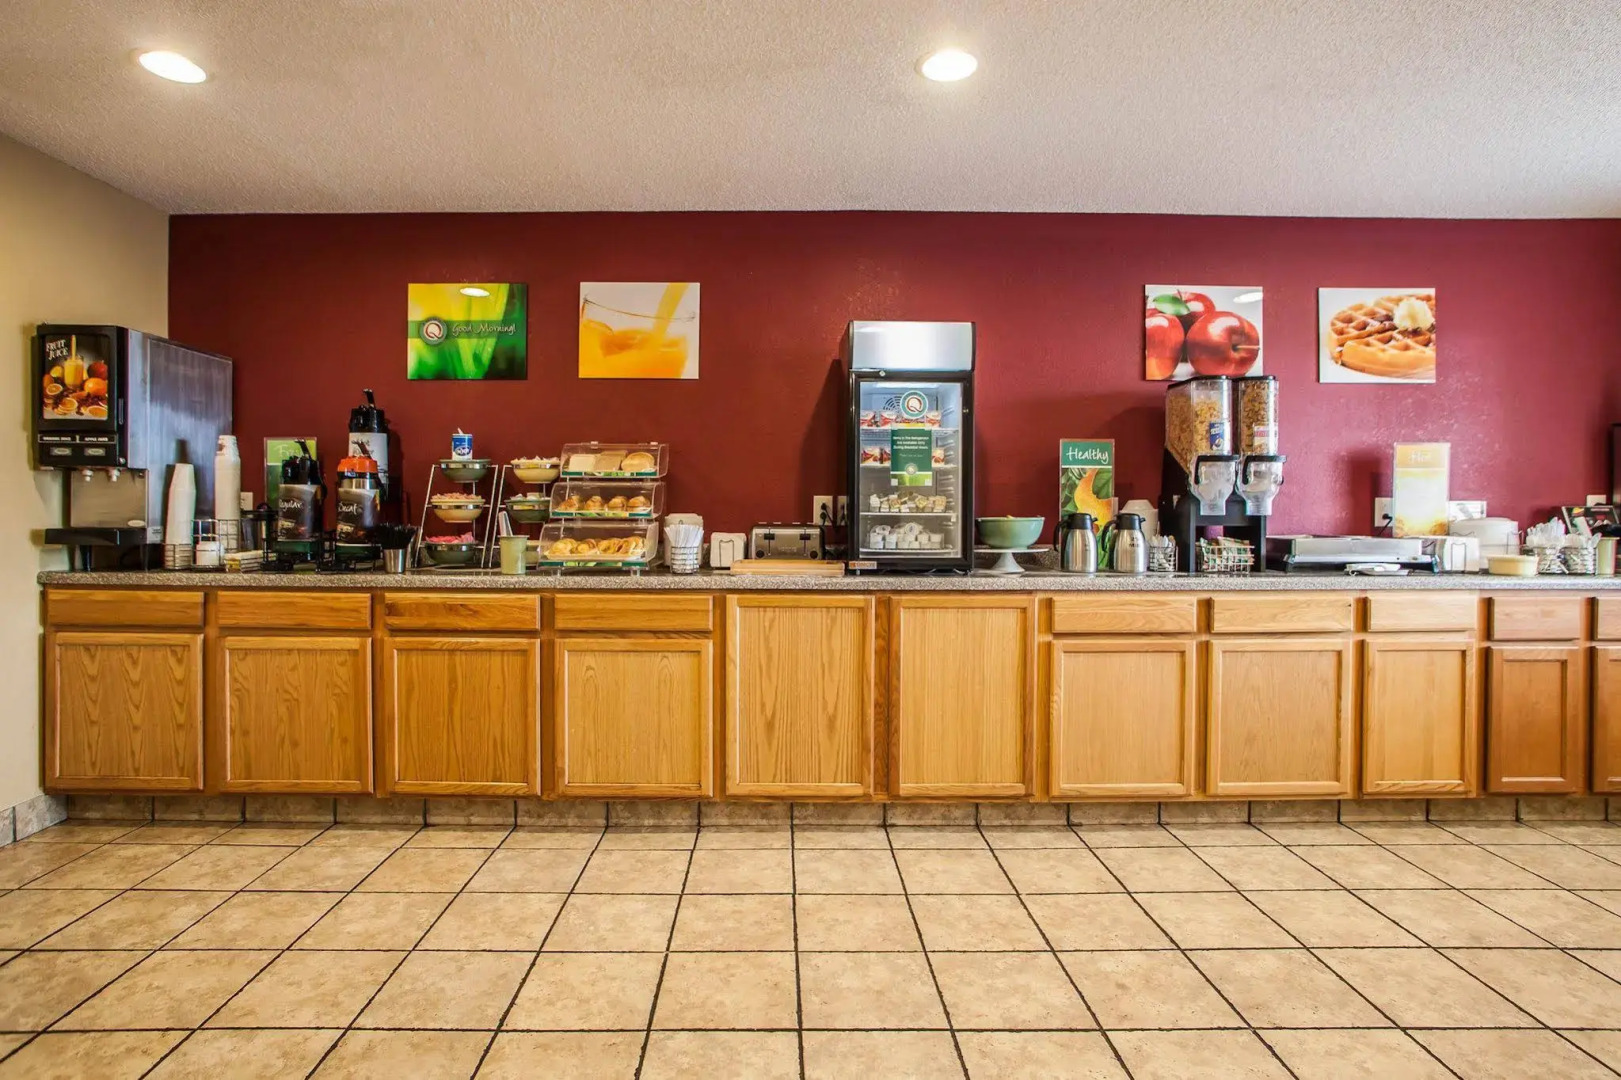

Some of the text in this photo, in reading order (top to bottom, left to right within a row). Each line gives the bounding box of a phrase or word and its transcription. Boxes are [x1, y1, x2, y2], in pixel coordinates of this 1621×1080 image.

[452, 323, 516, 336] Good Morning!
[46, 339, 66, 352] FRUIT
[48, 347, 69, 360] JUICE
[1066, 446, 1109, 465] Healthy
[338, 501, 358, 514] Decaf
